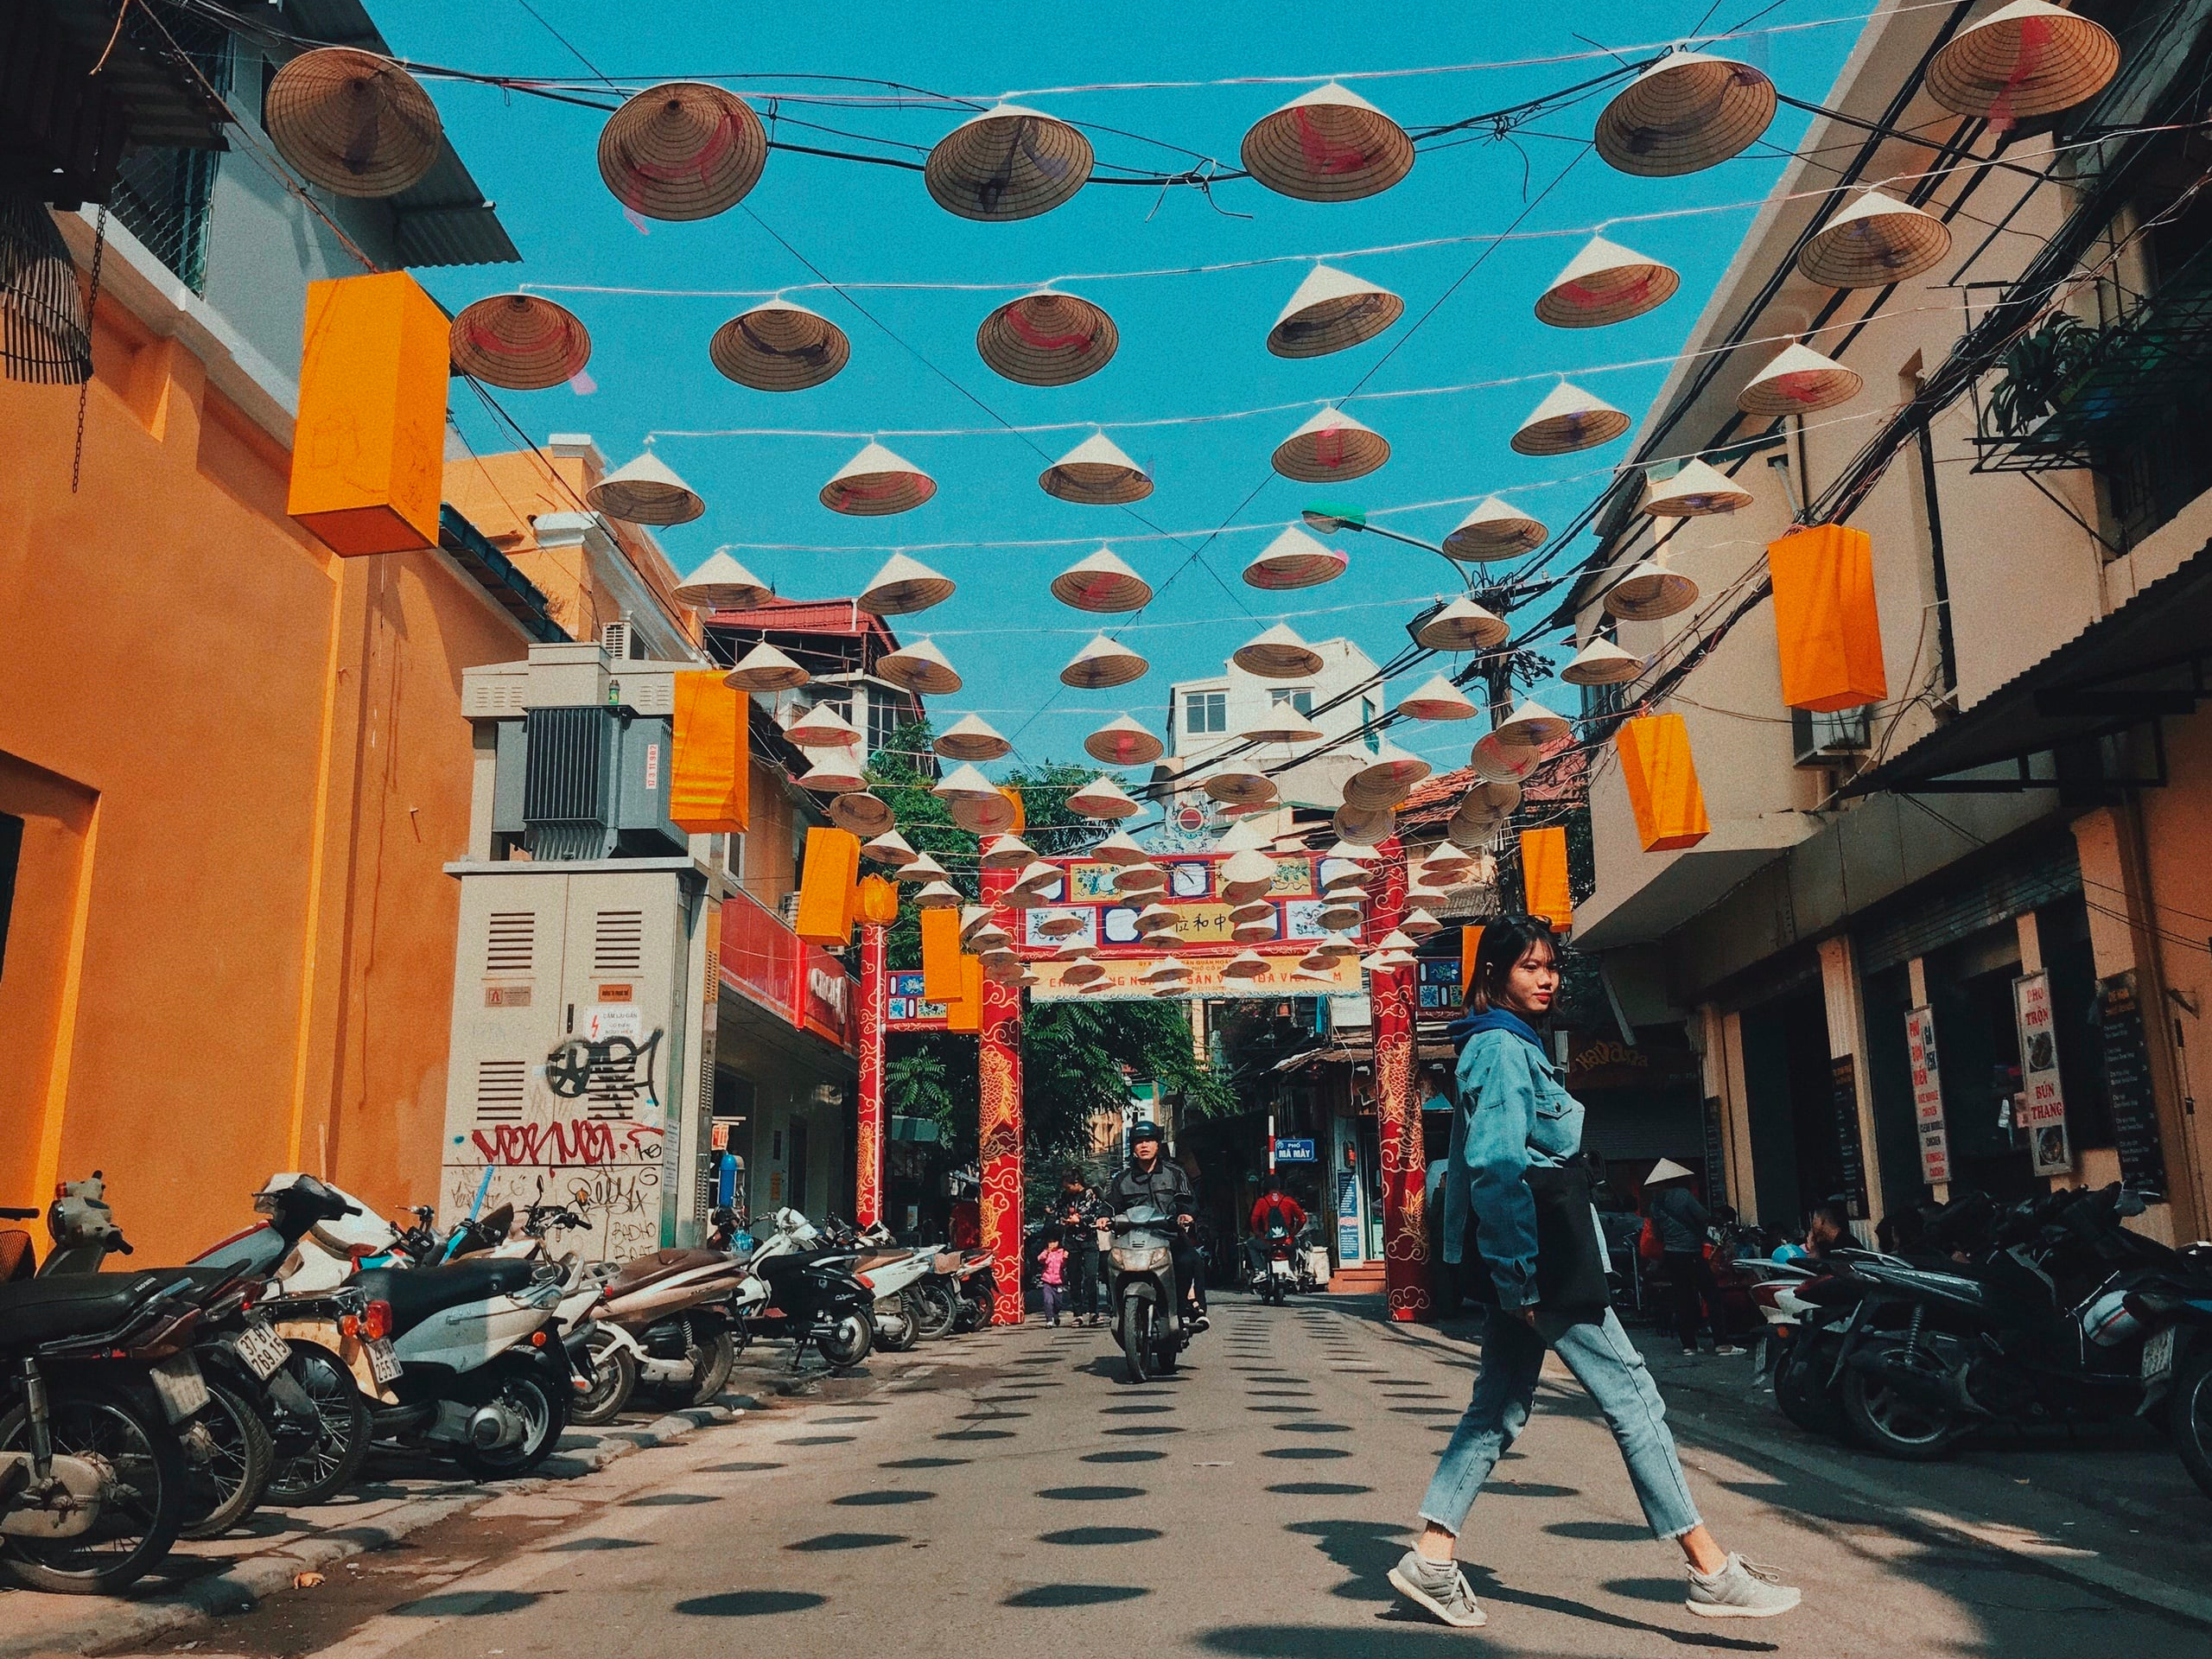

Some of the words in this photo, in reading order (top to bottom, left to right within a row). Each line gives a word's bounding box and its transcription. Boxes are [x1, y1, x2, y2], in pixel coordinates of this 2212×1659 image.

[2035, 1081, 2055, 1099] BÚN
[2031, 1102, 2063, 1120] THANG
[251, 1338, 287, 1376] 769.15
